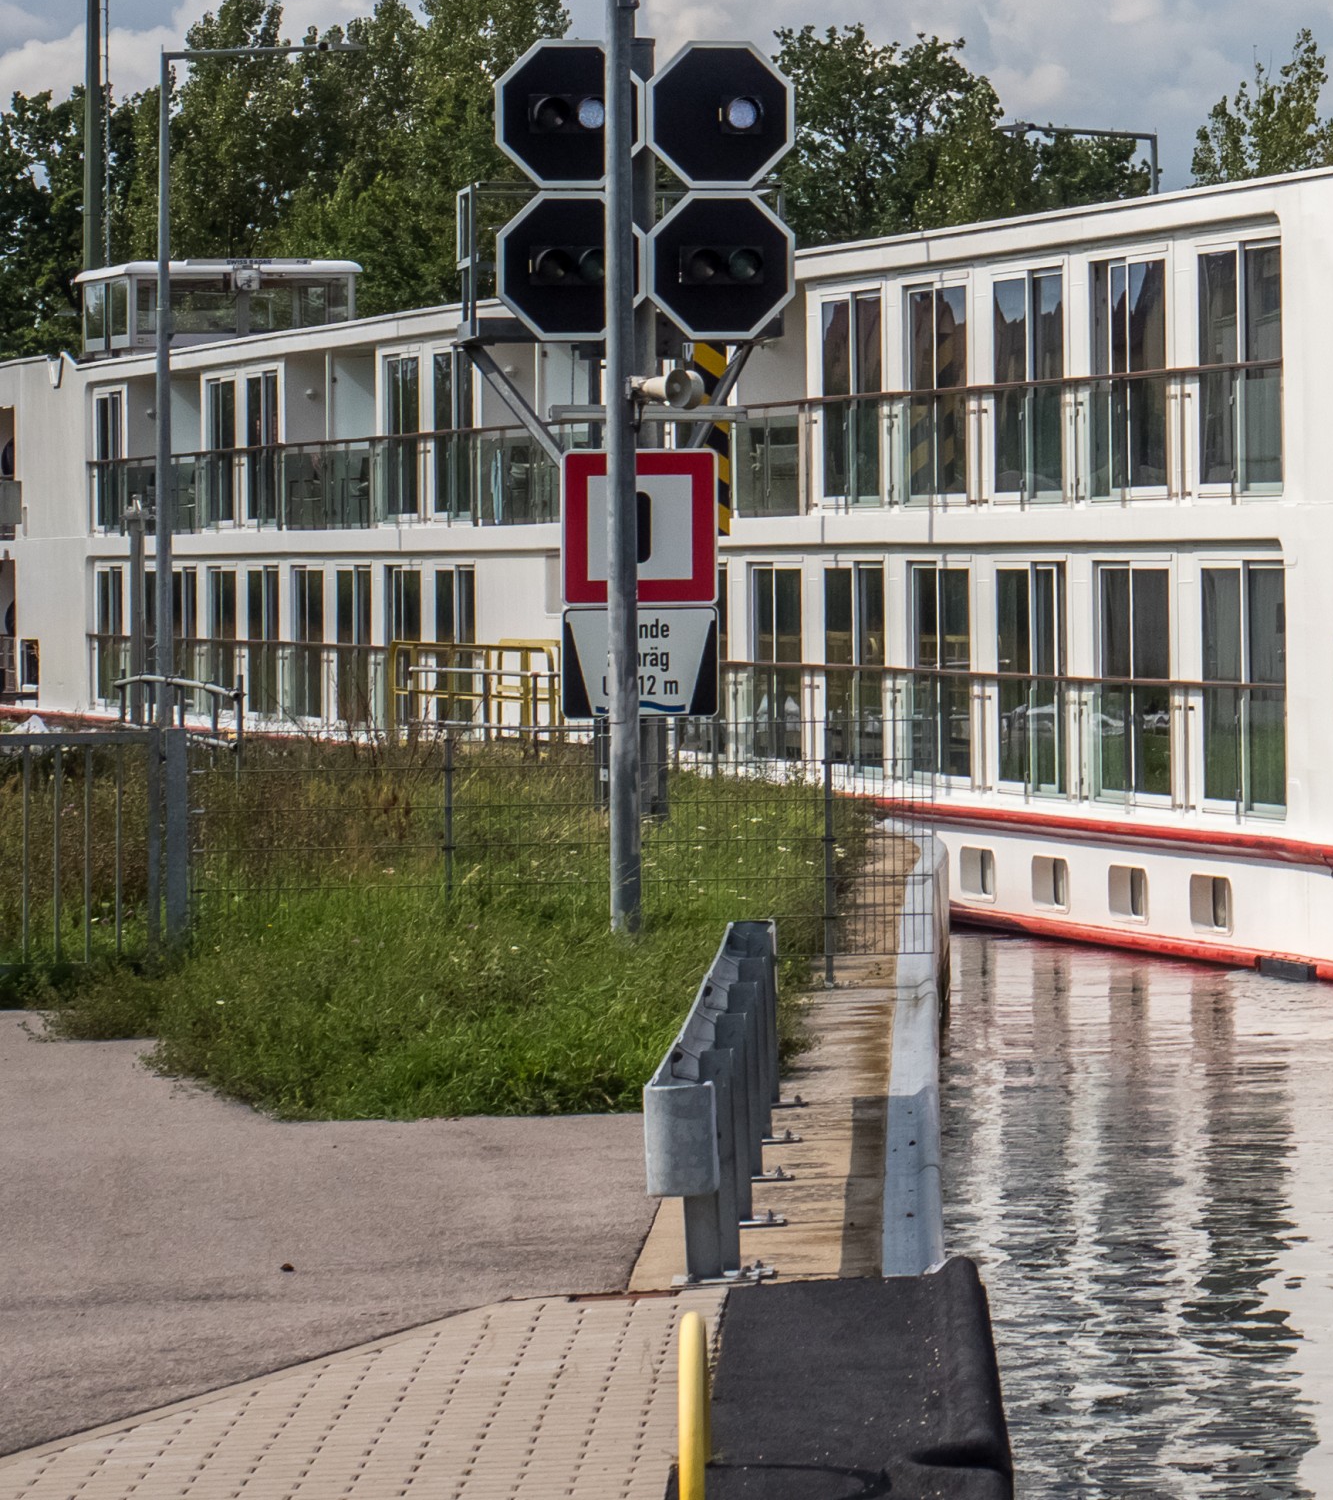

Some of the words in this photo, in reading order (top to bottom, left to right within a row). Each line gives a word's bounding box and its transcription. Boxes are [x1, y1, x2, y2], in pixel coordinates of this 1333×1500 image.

[638, 618, 670, 639] nde
[638, 675, 657, 696] 12
[663, 680, 679, 695] m
